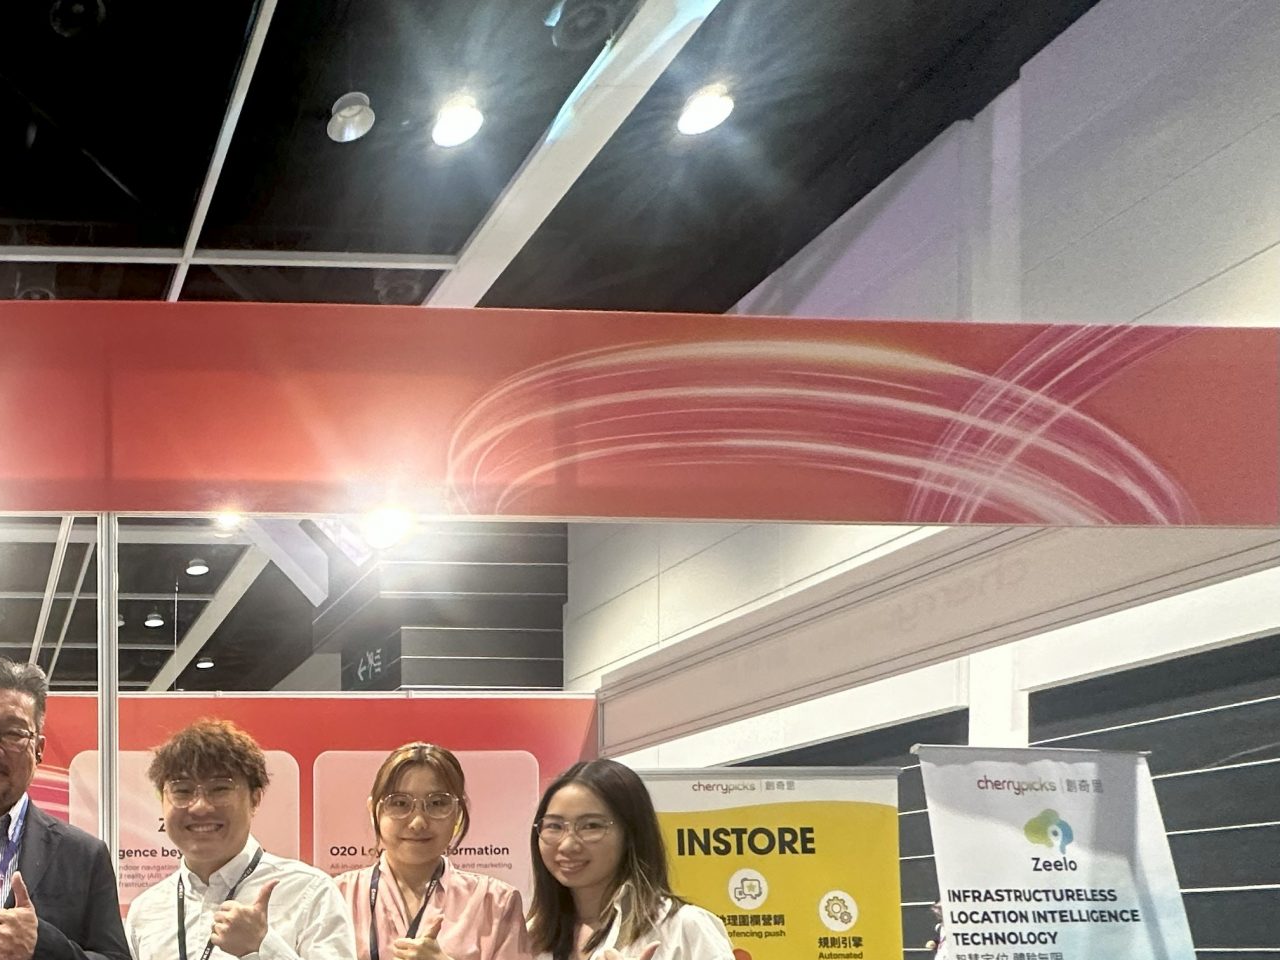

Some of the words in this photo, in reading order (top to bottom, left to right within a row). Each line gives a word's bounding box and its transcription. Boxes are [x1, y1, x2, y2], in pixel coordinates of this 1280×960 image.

[691, 781, 756, 794] cherrypicks
[977, 775, 1057, 796] cherrypicks
[677, 827, 816, 856] INSTORE
[330, 846, 358, 856] O2O
[443, 844, 510, 856] formation
[1032, 857, 1078, 872] Zeelo
[948, 888, 1118, 903] INFRASTRUCTURELESS
[950, 910, 1029, 925] LOCATION
[1032, 909, 1141, 924] INTELLIGENCE
[764, 930, 786, 939] push
[818, 936, 864, 948] 規則引擎
[953, 931, 1058, 946] TECHNOLOGY
[818, 952, 864, 960] Automated
